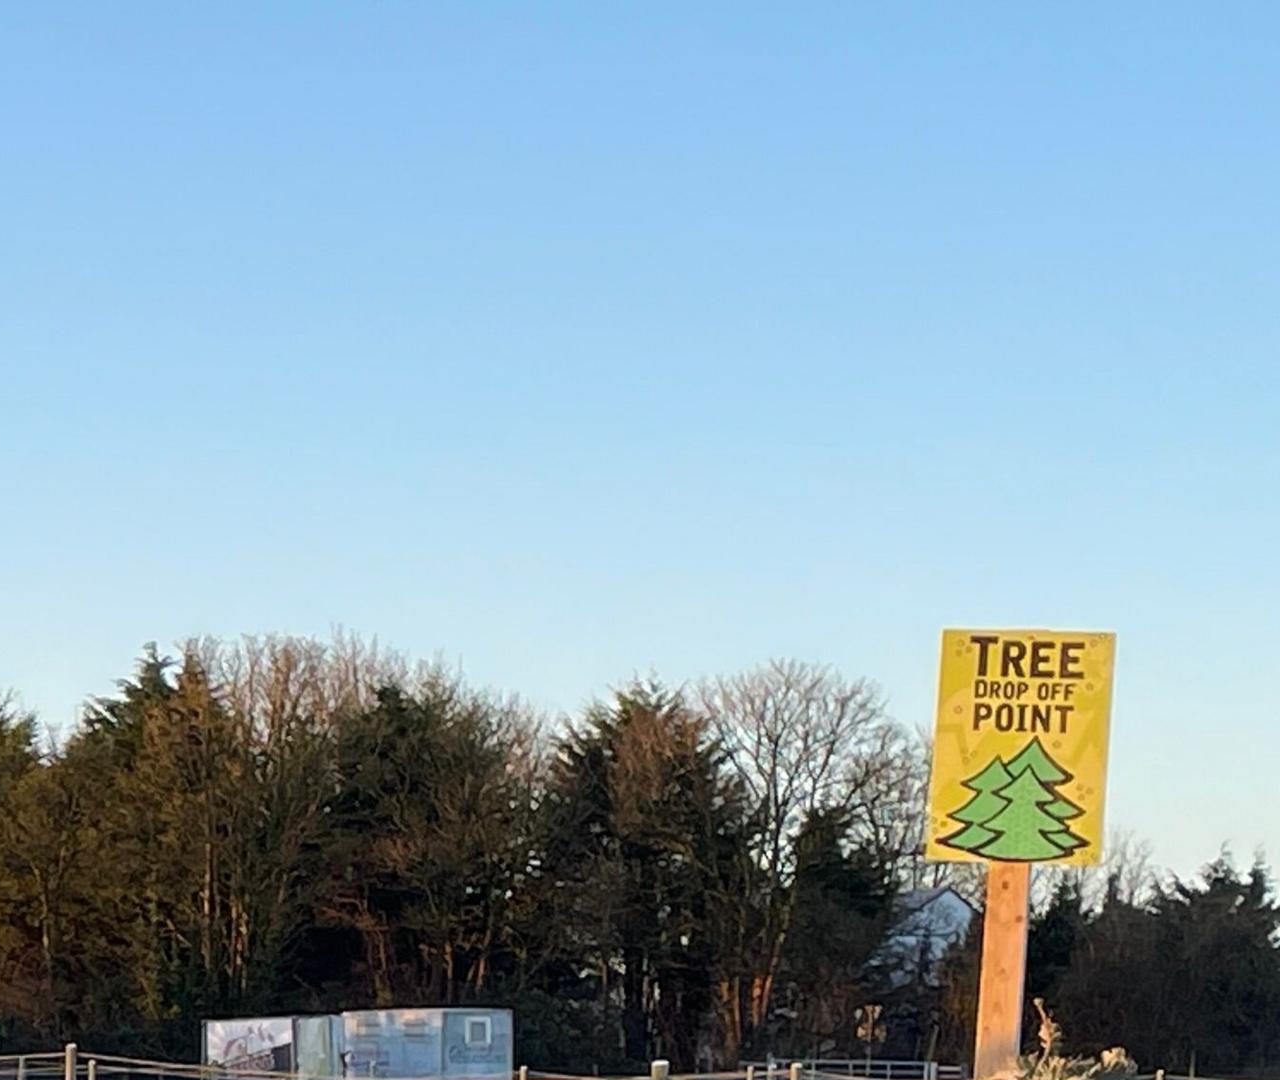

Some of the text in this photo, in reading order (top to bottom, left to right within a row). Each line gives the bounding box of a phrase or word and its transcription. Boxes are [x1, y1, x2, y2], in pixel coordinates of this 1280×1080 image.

[970, 635, 1086, 680] TREE
[974, 679, 1075, 701] DROP OFF
[972, 702, 1075, 734] POINT
